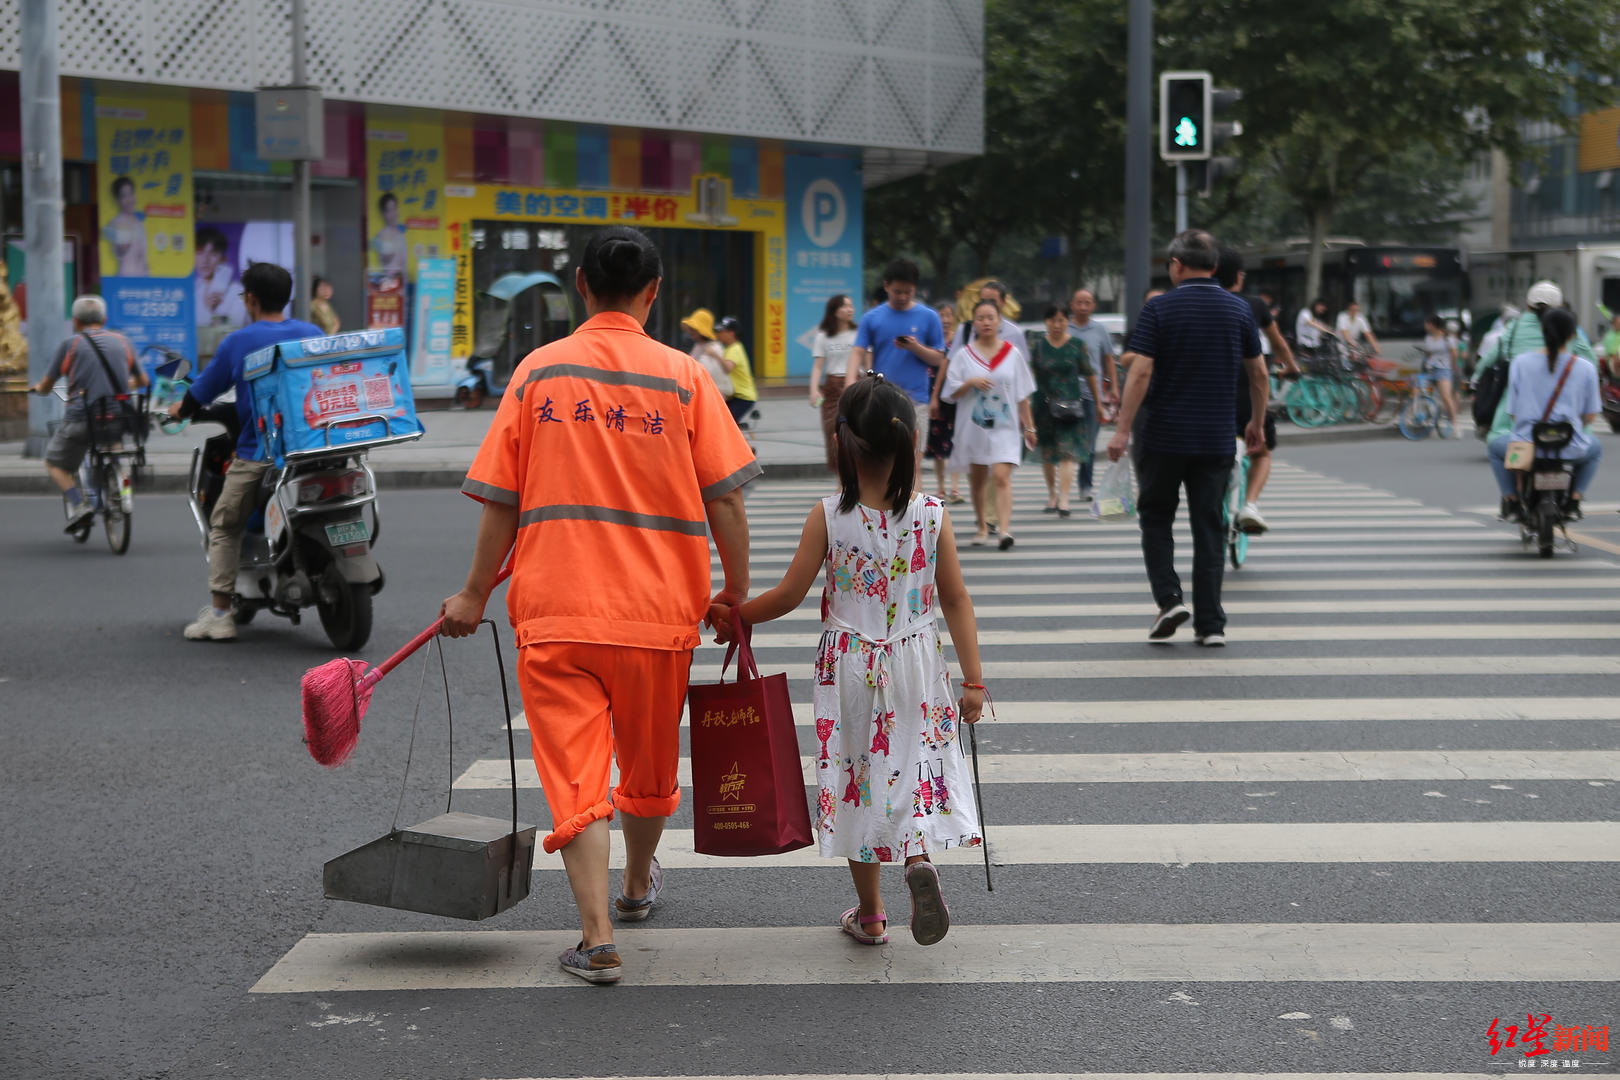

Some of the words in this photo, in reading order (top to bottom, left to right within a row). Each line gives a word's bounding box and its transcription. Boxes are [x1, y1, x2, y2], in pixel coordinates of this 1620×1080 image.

[495, 191, 608, 219] 美的空调
[625, 197, 678, 222] 半价
[814, 192, 836, 238] P
[538, 397, 665, 435] 友乐清洁
